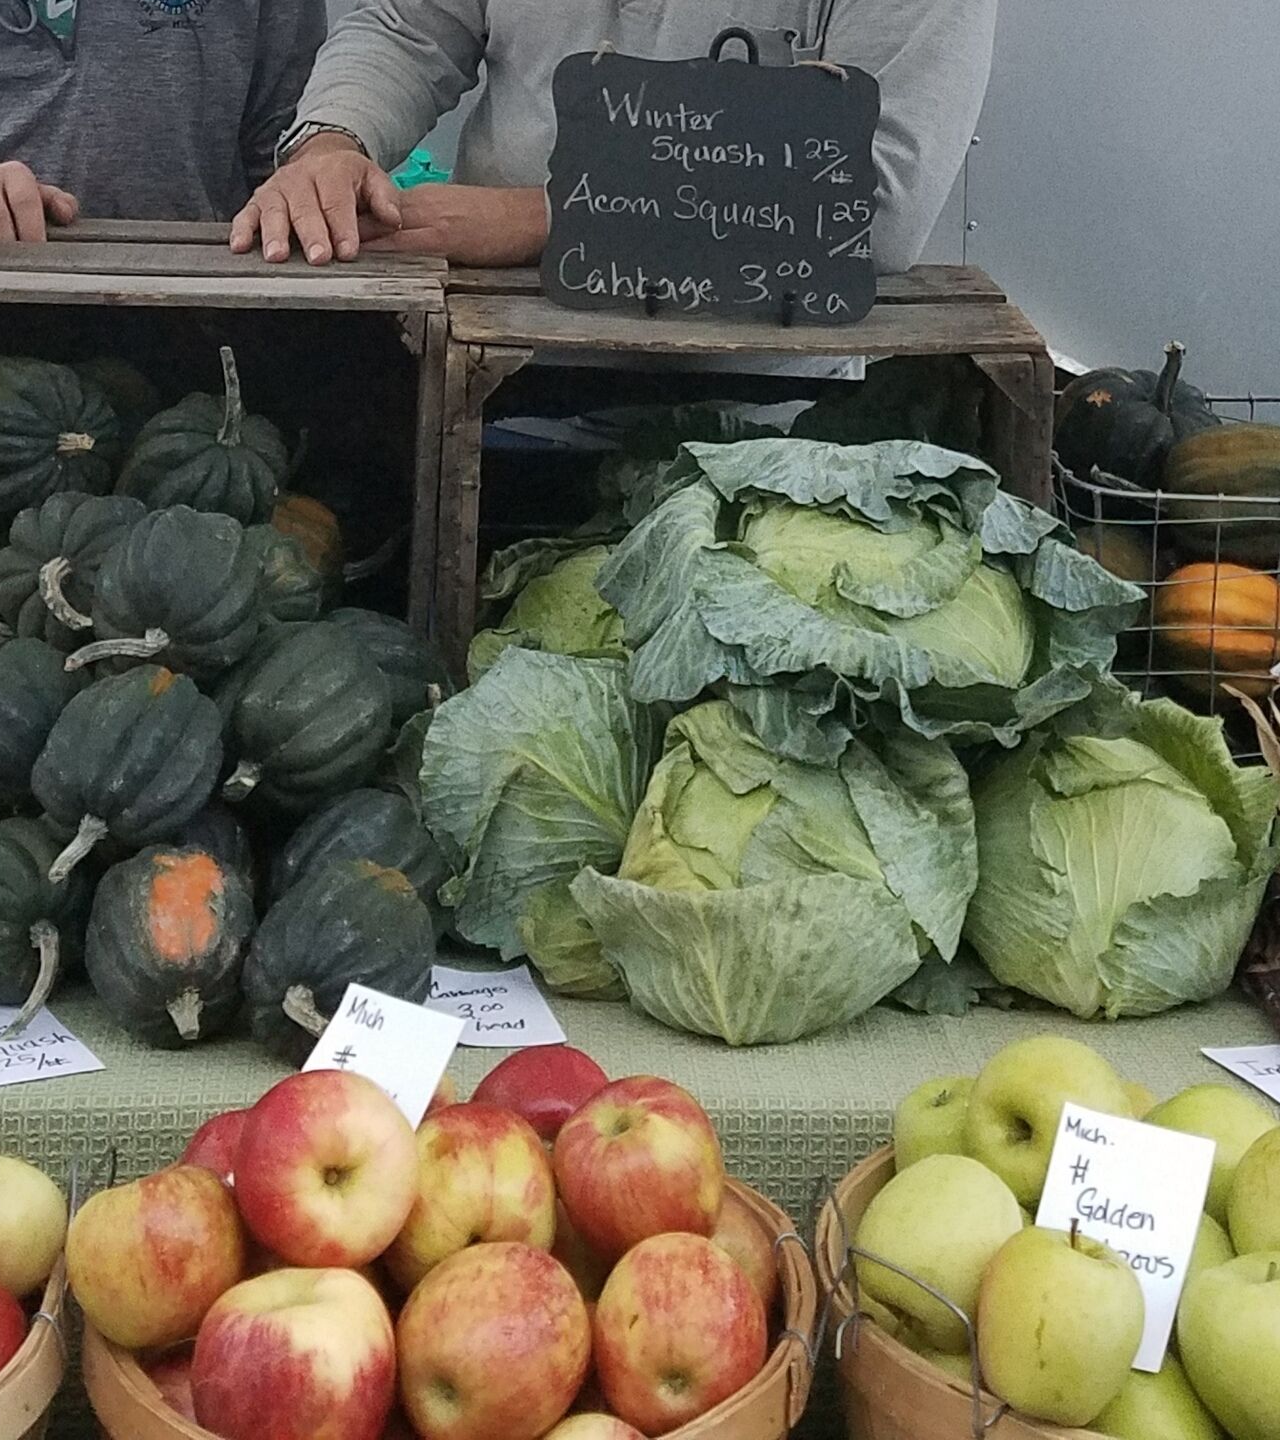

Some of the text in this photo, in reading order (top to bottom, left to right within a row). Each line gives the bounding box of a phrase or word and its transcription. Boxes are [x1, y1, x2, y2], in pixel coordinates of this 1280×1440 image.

[602, 81, 724, 132] Winter
[651, 136, 764, 172] Squash
[563, 173, 660, 218] Acorn
[674, 185, 795, 239] Squash
[802, 290, 849, 314] ea
[346, 996, 384, 1031] Mich
